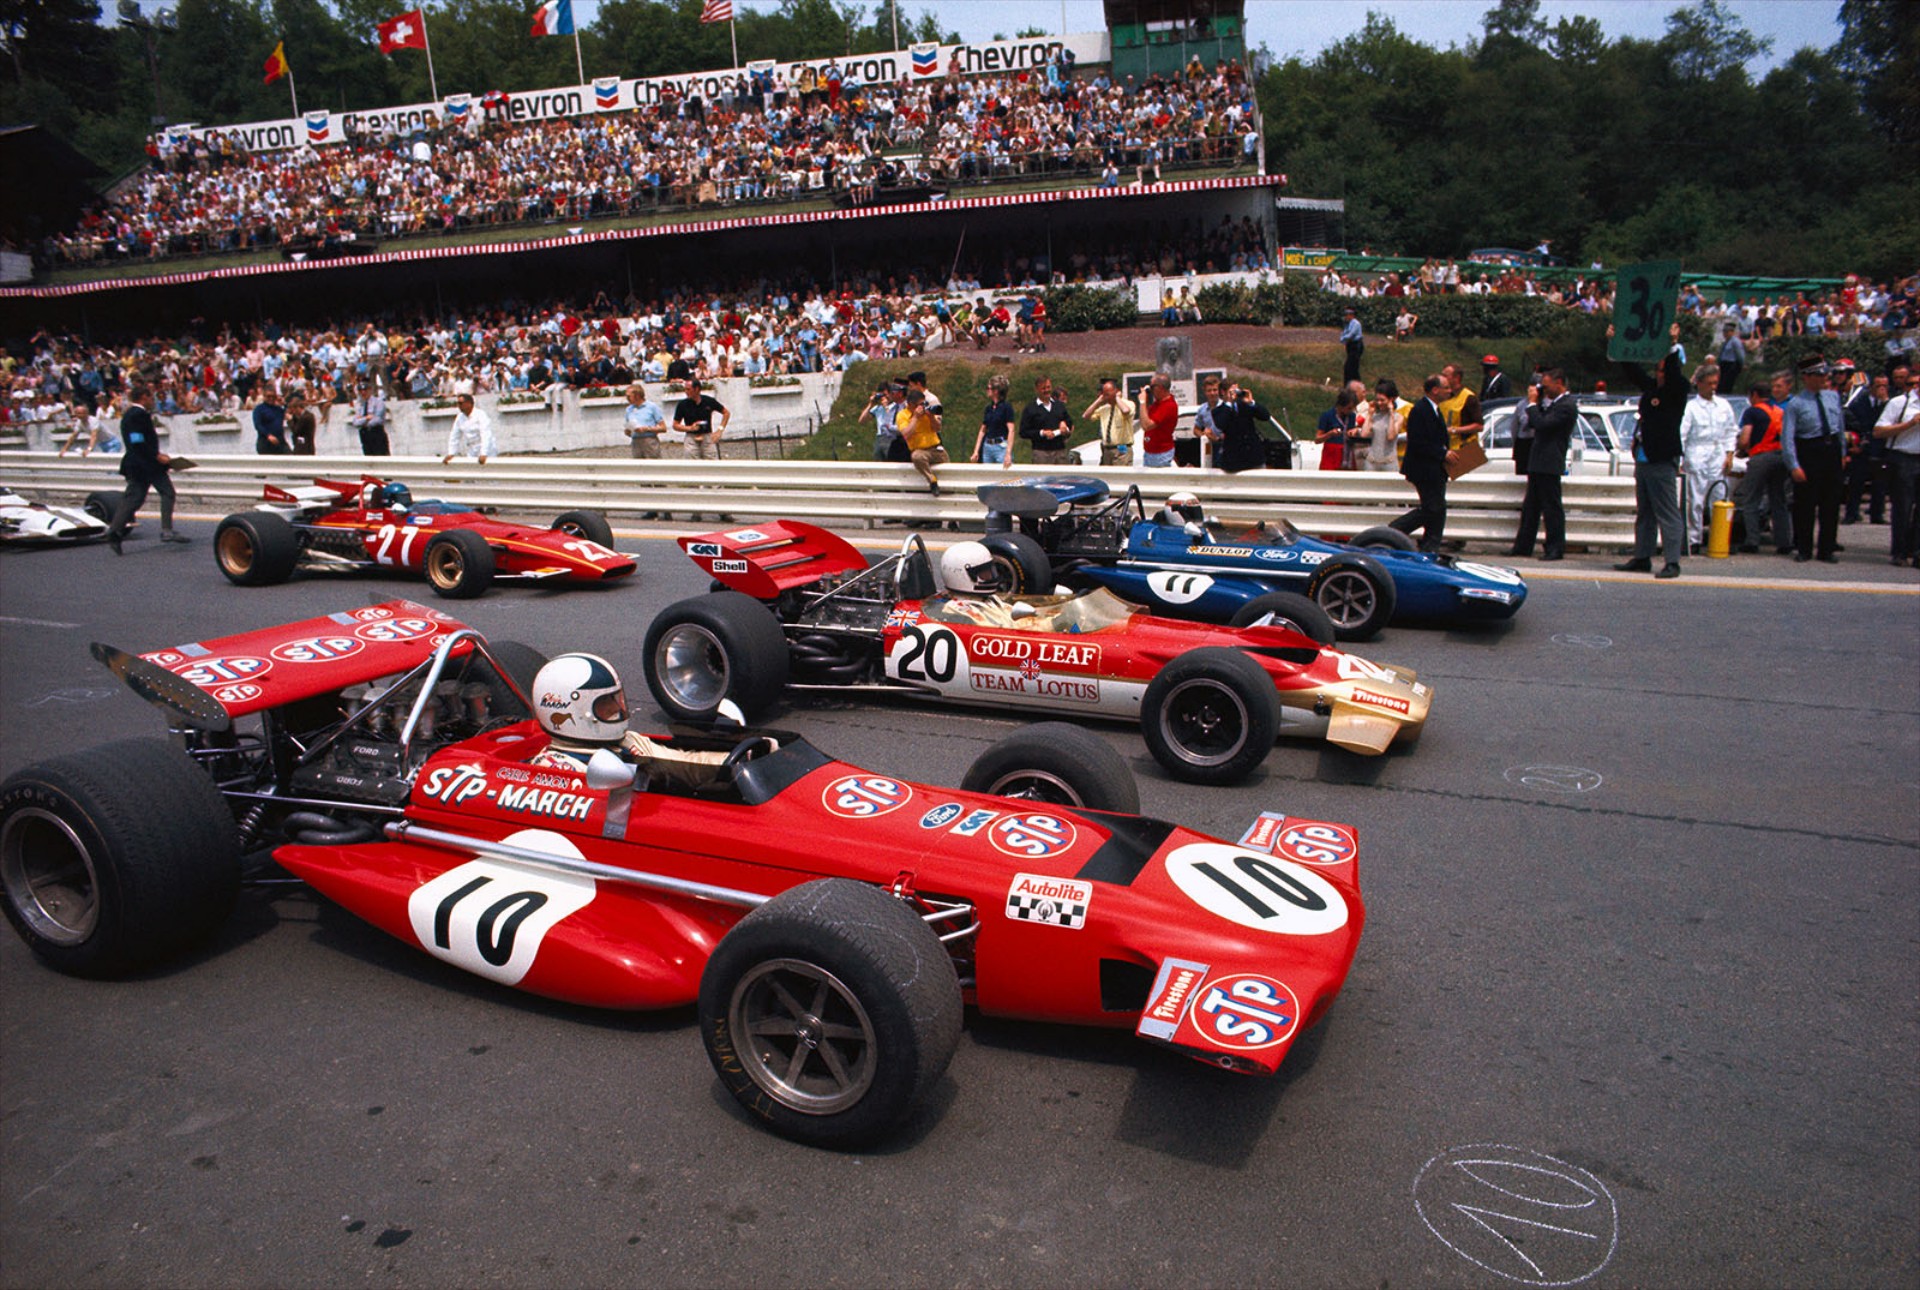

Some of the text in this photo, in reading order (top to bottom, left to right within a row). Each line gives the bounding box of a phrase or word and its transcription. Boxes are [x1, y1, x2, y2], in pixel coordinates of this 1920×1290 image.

[204, 124, 296, 150] Cvron
[376, 524, 420, 567] 27
[1200, 546, 1251, 556] DUNLOP
[1261, 548, 1291, 560] Ford
[714, 561, 746, 571] Shell
[1165, 575, 1197, 594] 11
[361, 609, 389, 621] STP
[367, 620, 429, 640] STP
[146, 653, 177, 665] TP
[284, 638, 355, 661] STP
[898, 627, 958, 683] 20
[972, 638, 1097, 665] GOLD LEAF
[181, 659, 262, 684] STP
[220, 685, 257, 701] STP
[971, 672, 1098, 700] TEAM LOTUS
[1354, 689, 1408, 711] Firestone
[353, 746, 379, 756] FORD
[496, 767, 570, 788] CHRIS AMON
[835, 778, 903, 815] STP
[927, 805, 958, 825] Ford
[999, 815, 1066, 856] STP
[1250, 819, 1277, 846] Firestone
[1284, 826, 1351, 862] STP
[1018, 878, 1086, 902] Autolite
[1191, 856, 1327, 919] 10
[435, 876, 548, 966] 10
[1153, 971, 1195, 1019] Firestone
[1201, 979, 1292, 1044] STP
